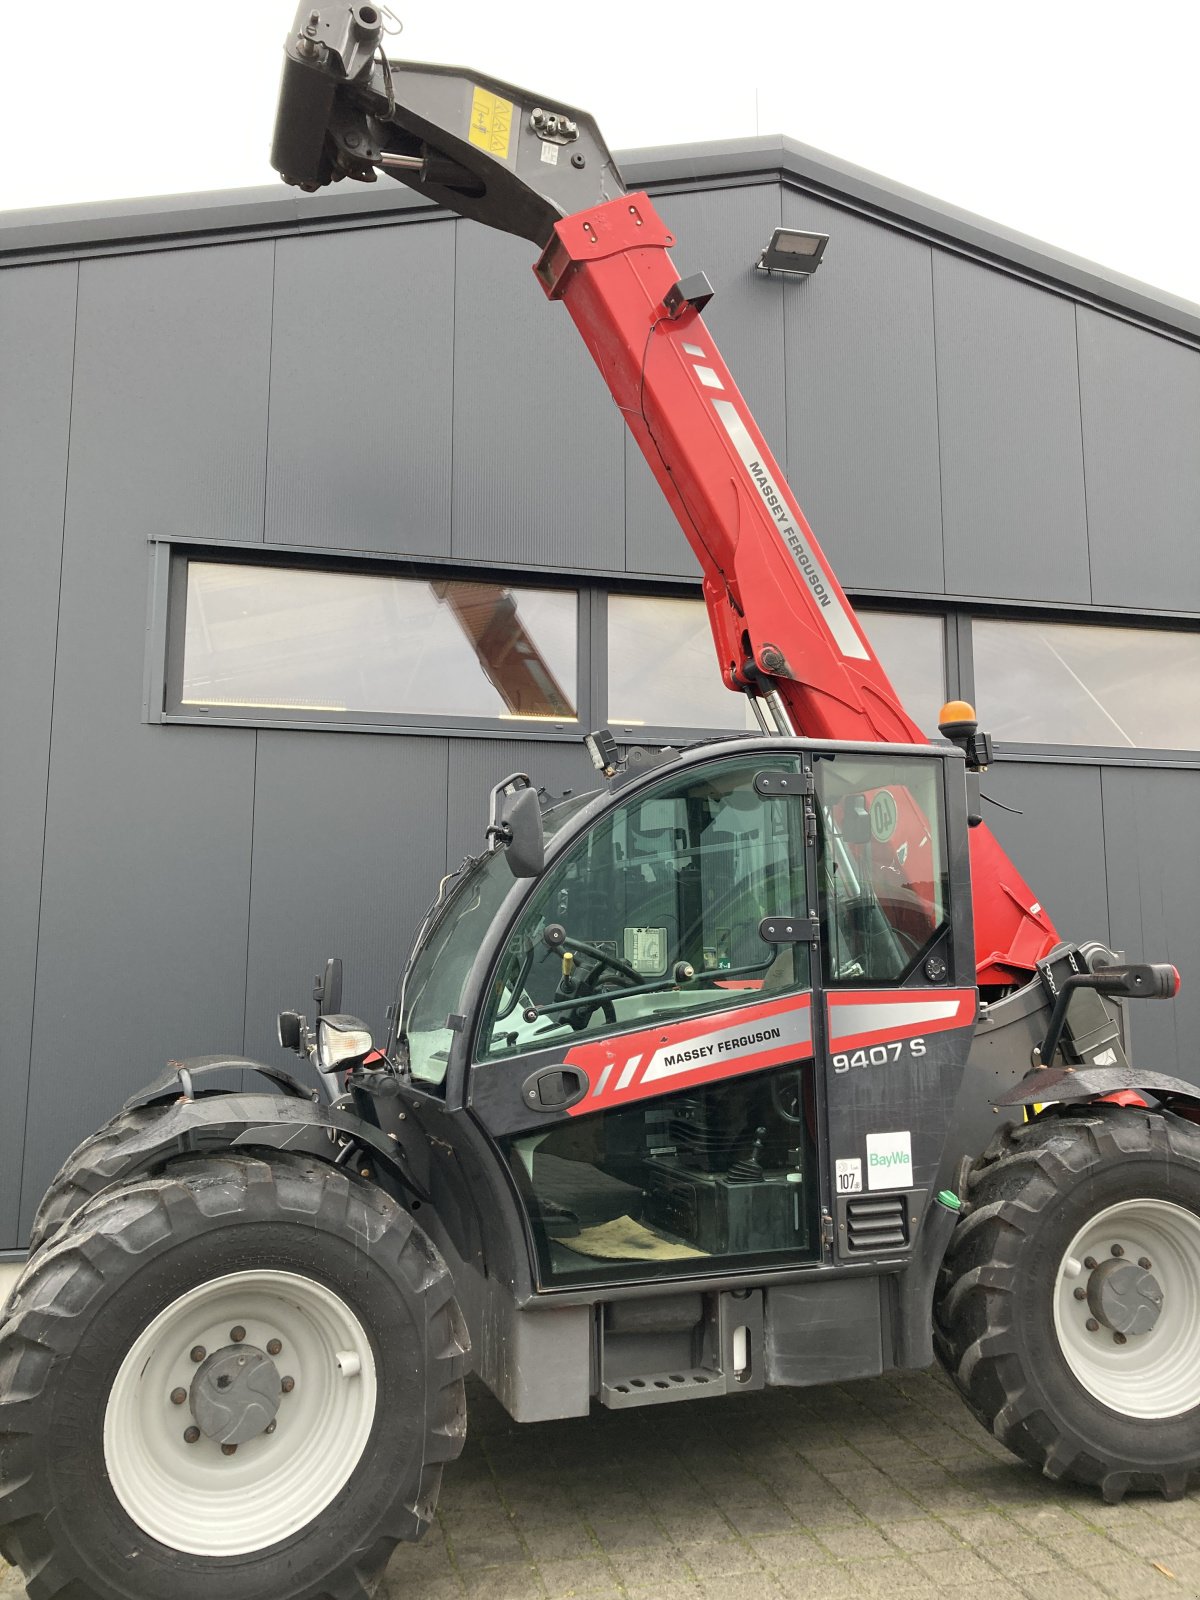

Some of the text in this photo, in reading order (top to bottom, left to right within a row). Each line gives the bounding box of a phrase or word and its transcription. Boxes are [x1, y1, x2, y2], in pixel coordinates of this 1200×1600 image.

[749, 461, 832, 608] MASSEY FERGUSON
[663, 1027, 781, 1067] MASSEY FERGUSON
[832, 1037, 927, 1074] 9407 S
[869, 1150, 910, 1168] BayWa
[838, 1173, 855, 1190] 107
